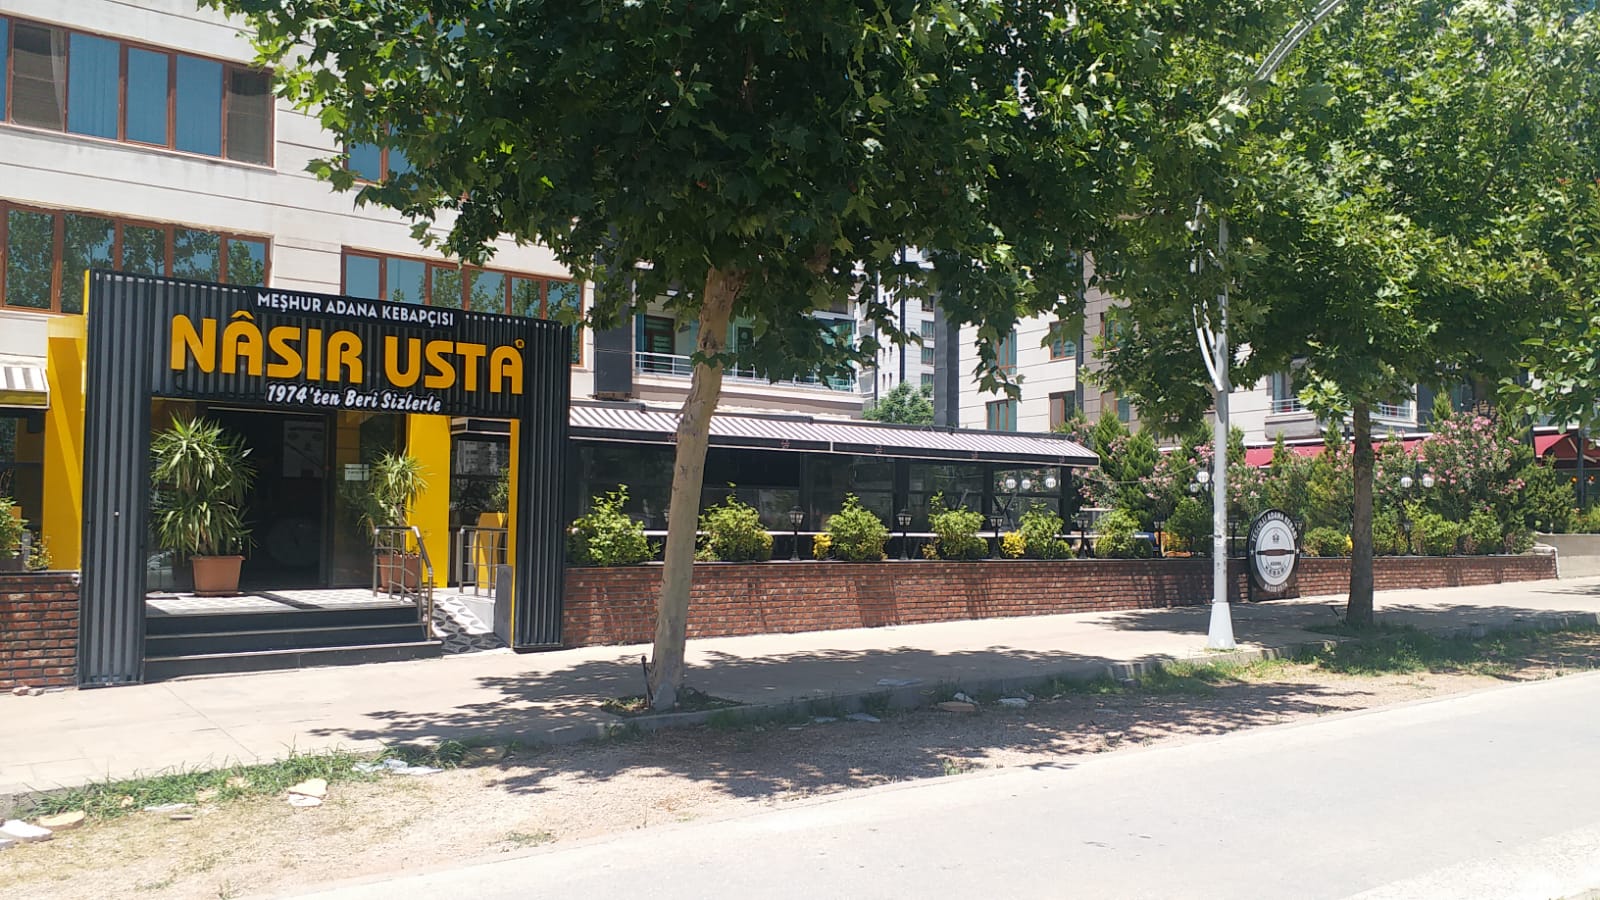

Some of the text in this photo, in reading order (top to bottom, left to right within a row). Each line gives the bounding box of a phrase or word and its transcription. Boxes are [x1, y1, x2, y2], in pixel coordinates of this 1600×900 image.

[257, 292, 454, 327] MEŞHUR ADANA KEBAPÇISI
[170, 310, 524, 395] NÂSIR USTA
[267, 385, 441, 412] 1974'ten Beri Sizlerle
